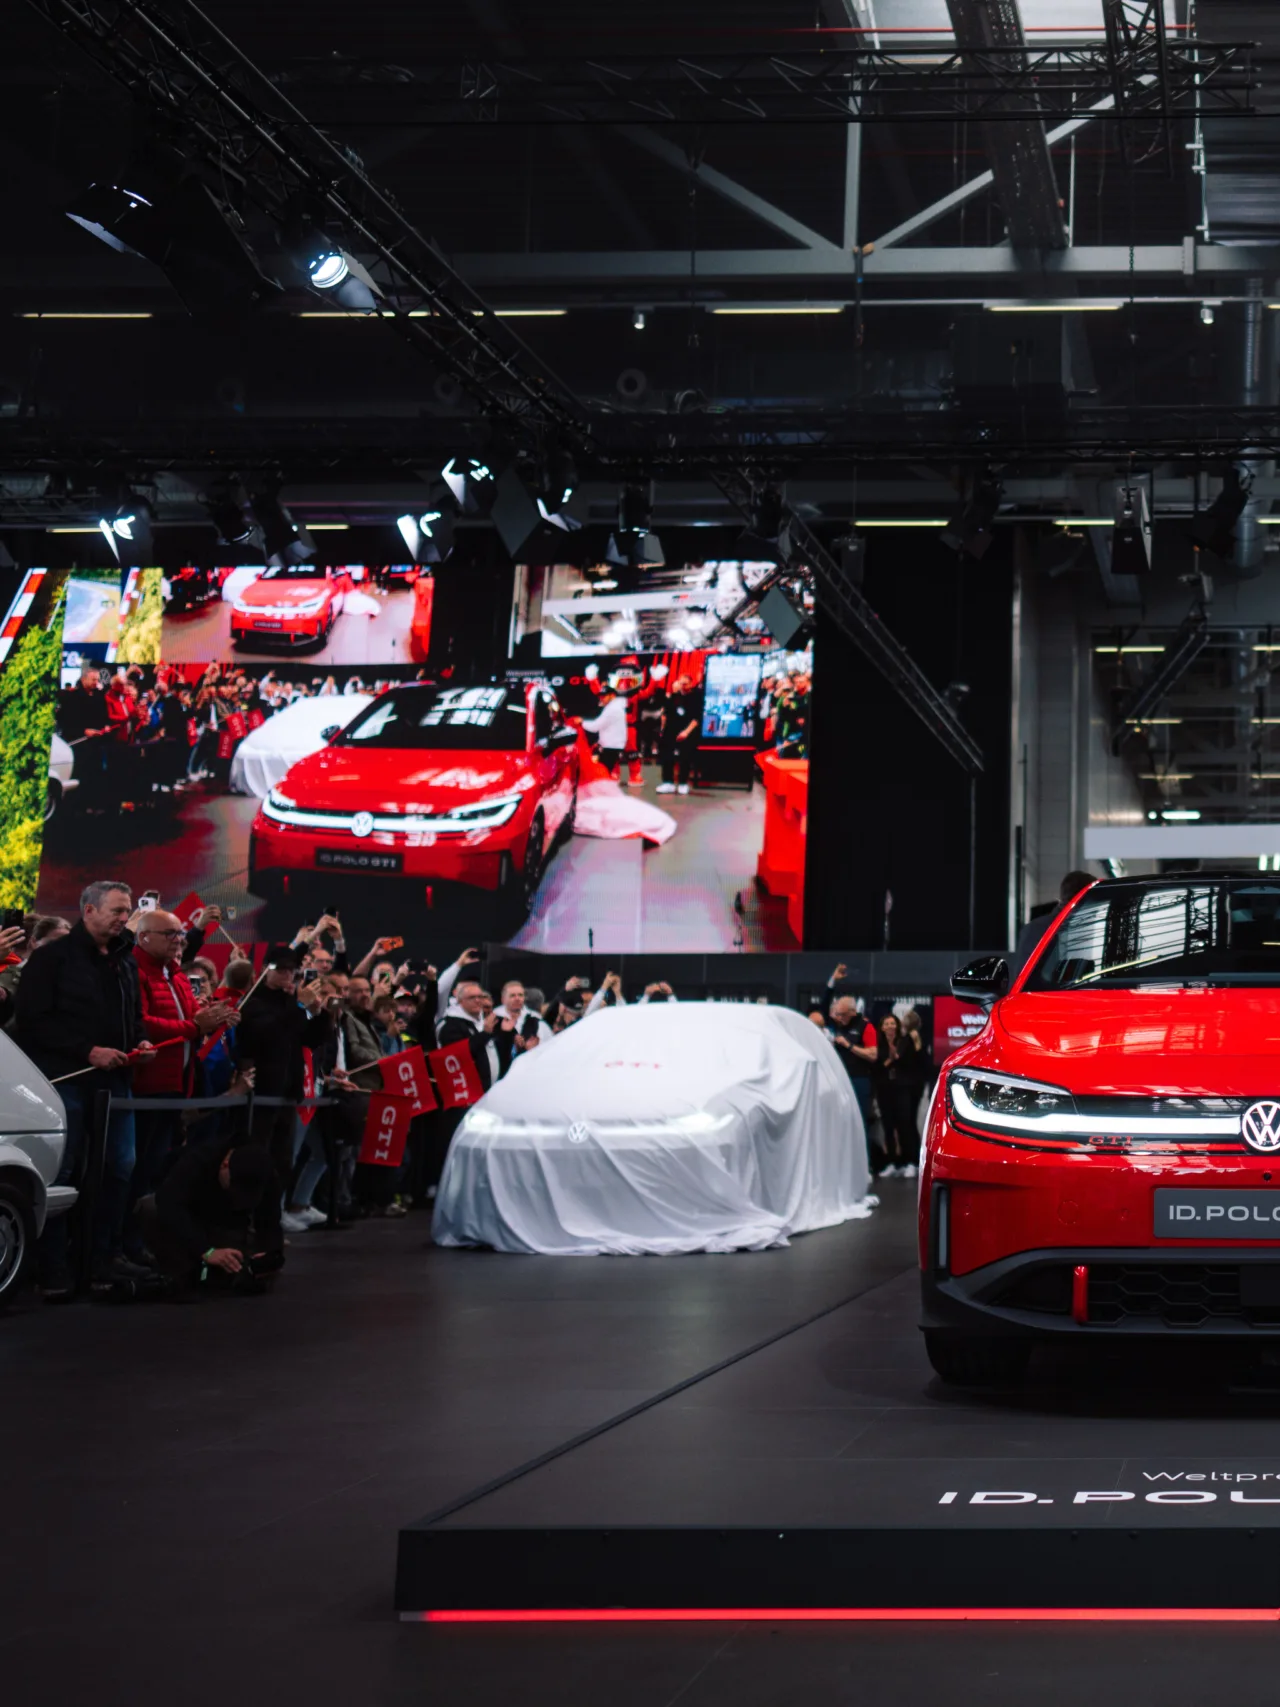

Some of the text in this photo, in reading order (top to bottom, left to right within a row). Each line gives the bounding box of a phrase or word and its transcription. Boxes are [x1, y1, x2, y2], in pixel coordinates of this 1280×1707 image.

[445, 1055, 469, 1102] GTI
[374, 1105, 397, 1161] GTI
[1088, 1135, 1134, 1146] GTI
